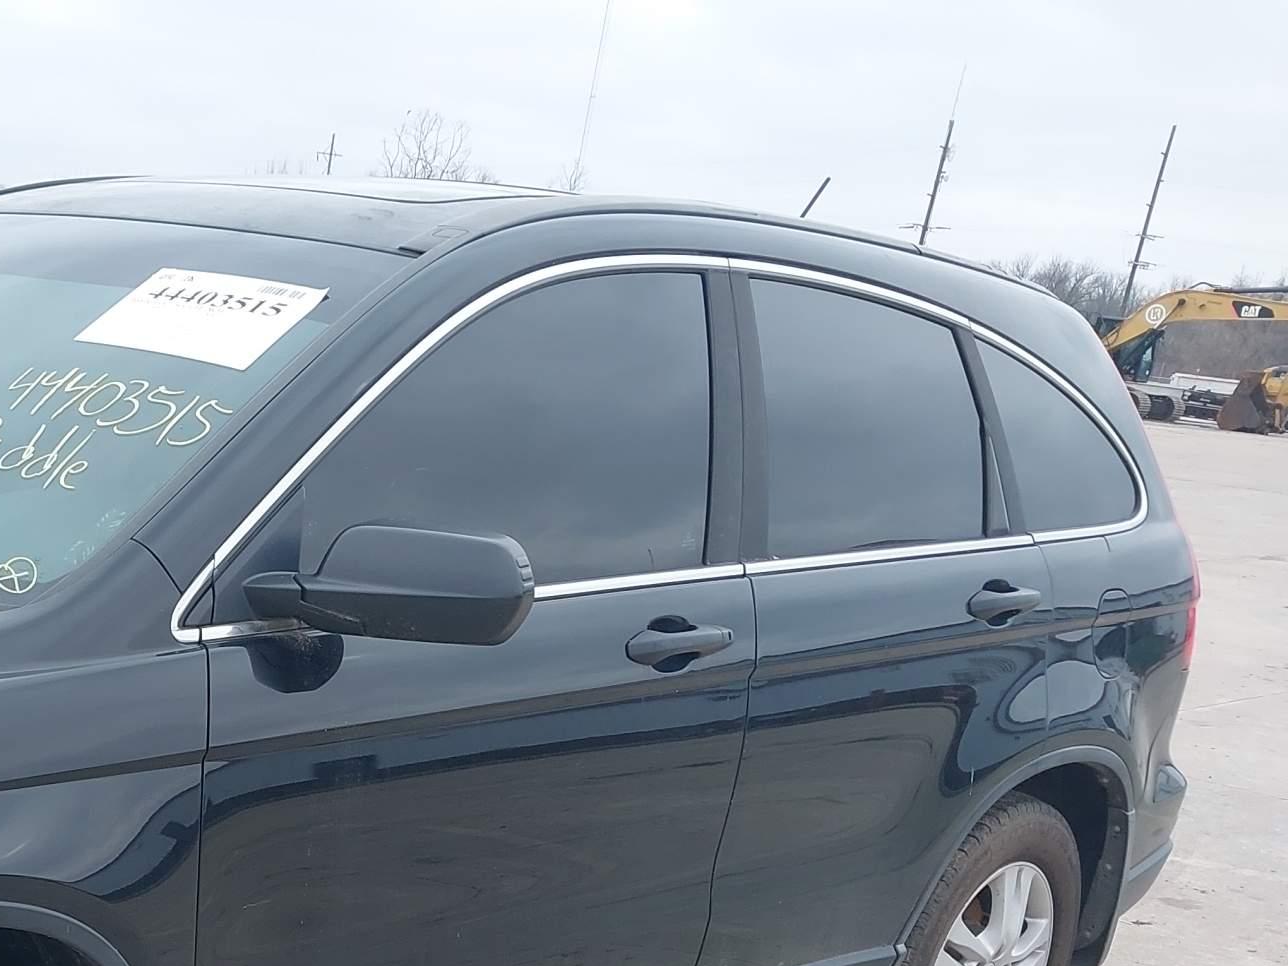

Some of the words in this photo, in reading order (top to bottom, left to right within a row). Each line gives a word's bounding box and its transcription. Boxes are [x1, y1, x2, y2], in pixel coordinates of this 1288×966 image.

[148, 286, 288, 317] 44403515
[1241, 305, 1262, 317] CAT
[8, 367, 233, 447] 44403515
